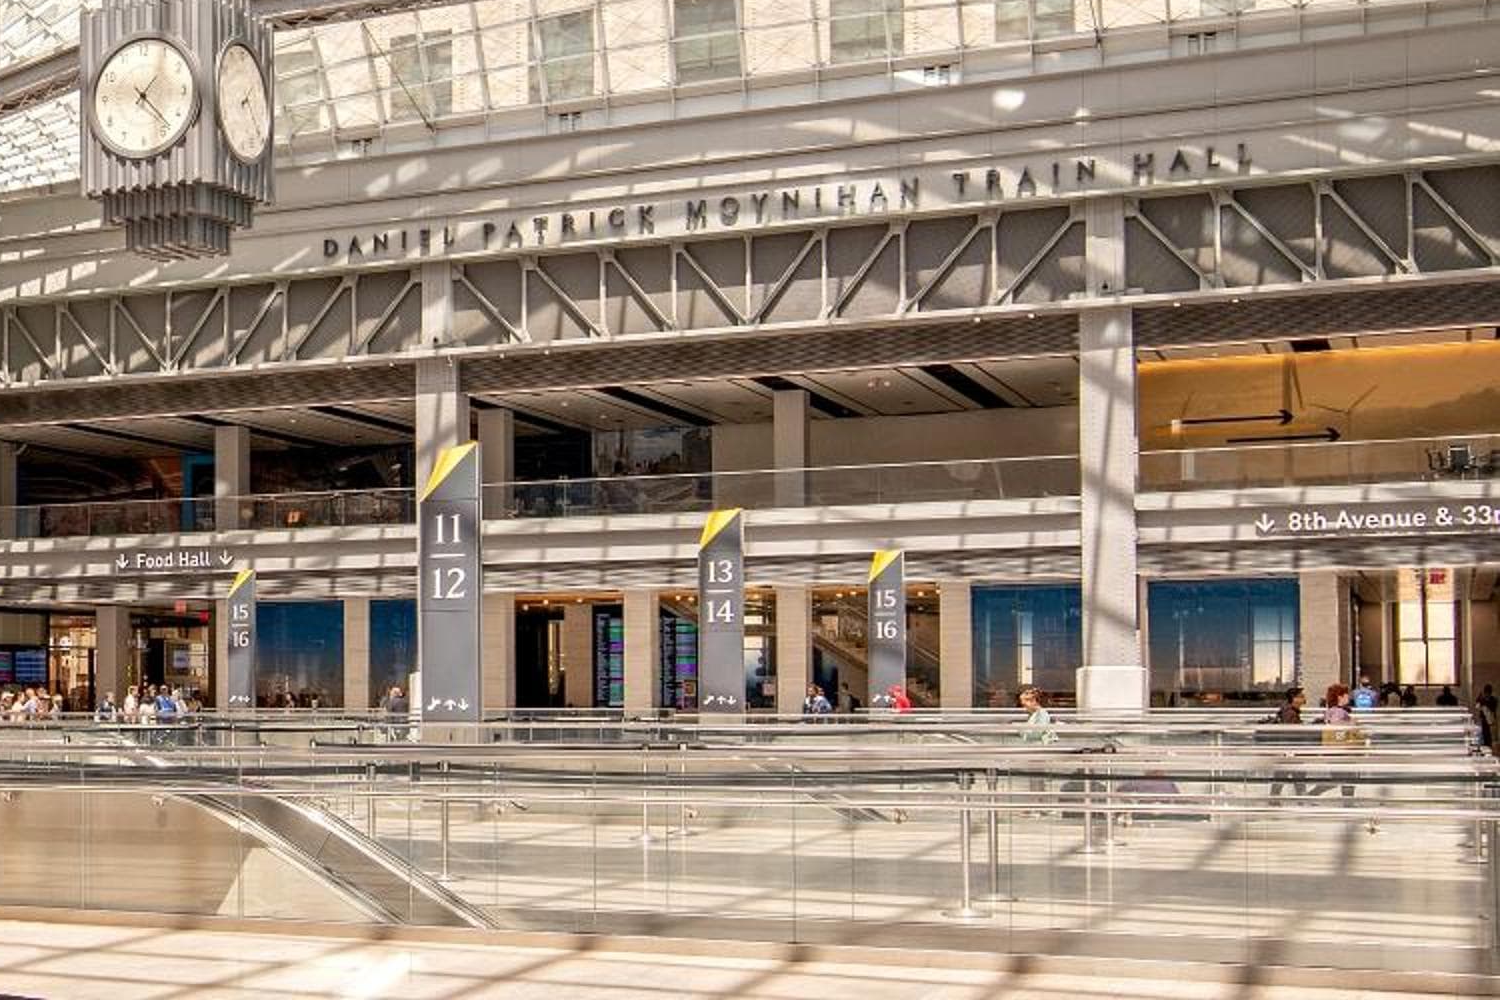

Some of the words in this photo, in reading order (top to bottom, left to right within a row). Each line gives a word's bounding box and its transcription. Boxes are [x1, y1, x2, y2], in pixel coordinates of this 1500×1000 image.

[323, 227, 456, 258] DANIEL
[482, 205, 655, 250] PATRICK
[685, 177, 918, 231] MOYNIHAN
[953, 160, 1096, 198] TRAIN
[1133, 143, 1252, 184] HALL
[436, 513, 461, 545] 11
[1288, 512, 1327, 532] 8th
[1335, 509, 1427, 530] Avenue
[1435, 507, 1453, 526] &
[136, 552, 173, 569] Food
[179, 551, 211, 567] Hall
[707, 559, 733, 583] 13
[432, 567, 466, 600] 12
[875, 589, 897, 609] 15
[231, 604, 249, 620] 15
[706, 600, 735, 623] 14
[232, 631, 249, 648] 16
[875, 620, 898, 639] 16
